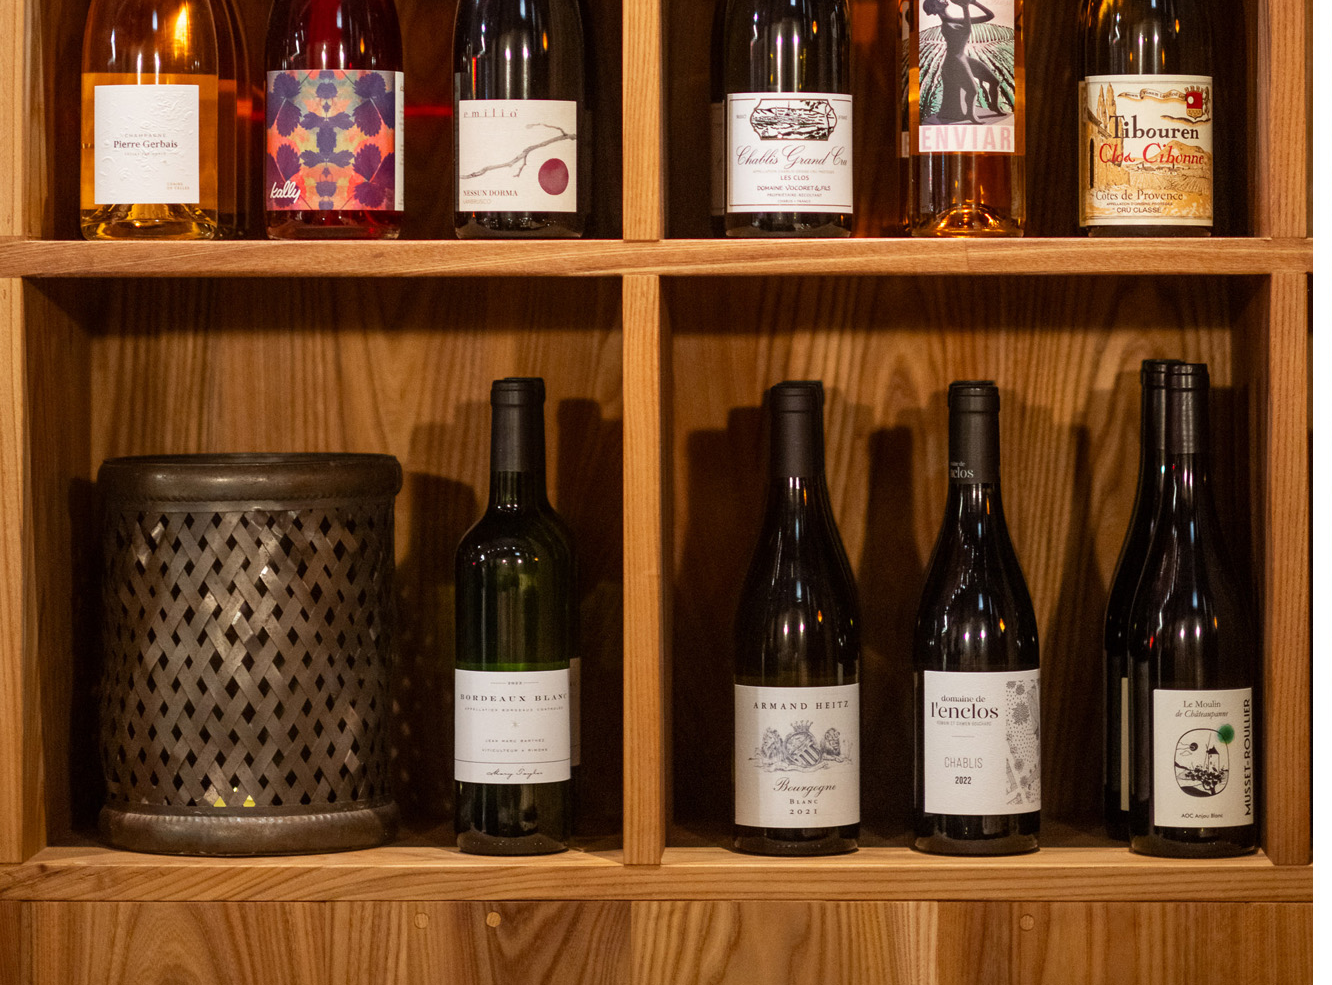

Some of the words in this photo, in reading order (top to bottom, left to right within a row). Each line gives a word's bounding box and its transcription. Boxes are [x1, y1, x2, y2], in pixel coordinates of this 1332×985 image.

[1109, 115, 1199, 139] Tibouren
[113, 141, 141, 149] Pierre
[142, 140, 178, 149] Gerbais
[922, 126, 1012, 151] ENVIAR
[735, 145, 779, 166] Chablis
[782, 145, 831, 169] Grand
[830, 146, 848, 166] Cru
[1099, 143, 1136, 164] Clos
[1142, 142, 1204, 164] Cibonne
[489, 189, 519, 197] DORMA
[1121, 189, 1134, 201] de
[1137, 189, 1184, 201] Provence
[460, 693, 526, 702] BORDEAUX
[534, 693, 568, 702] BLANC
[941, 694, 974, 703] domaine
[975, 695, 986, 703] de
[753, 702, 808, 710] ARMAND
[815, 700, 849, 710] HEITZ
[1183, 700, 1193, 708] Le
[1195, 700, 1221, 708] Moulin
[931, 701, 999, 720] l'enclos
[944, 756, 983, 769] CHABLIS
[955, 776, 972, 785] 2022
[773, 777, 837, 798] Bourgogne
